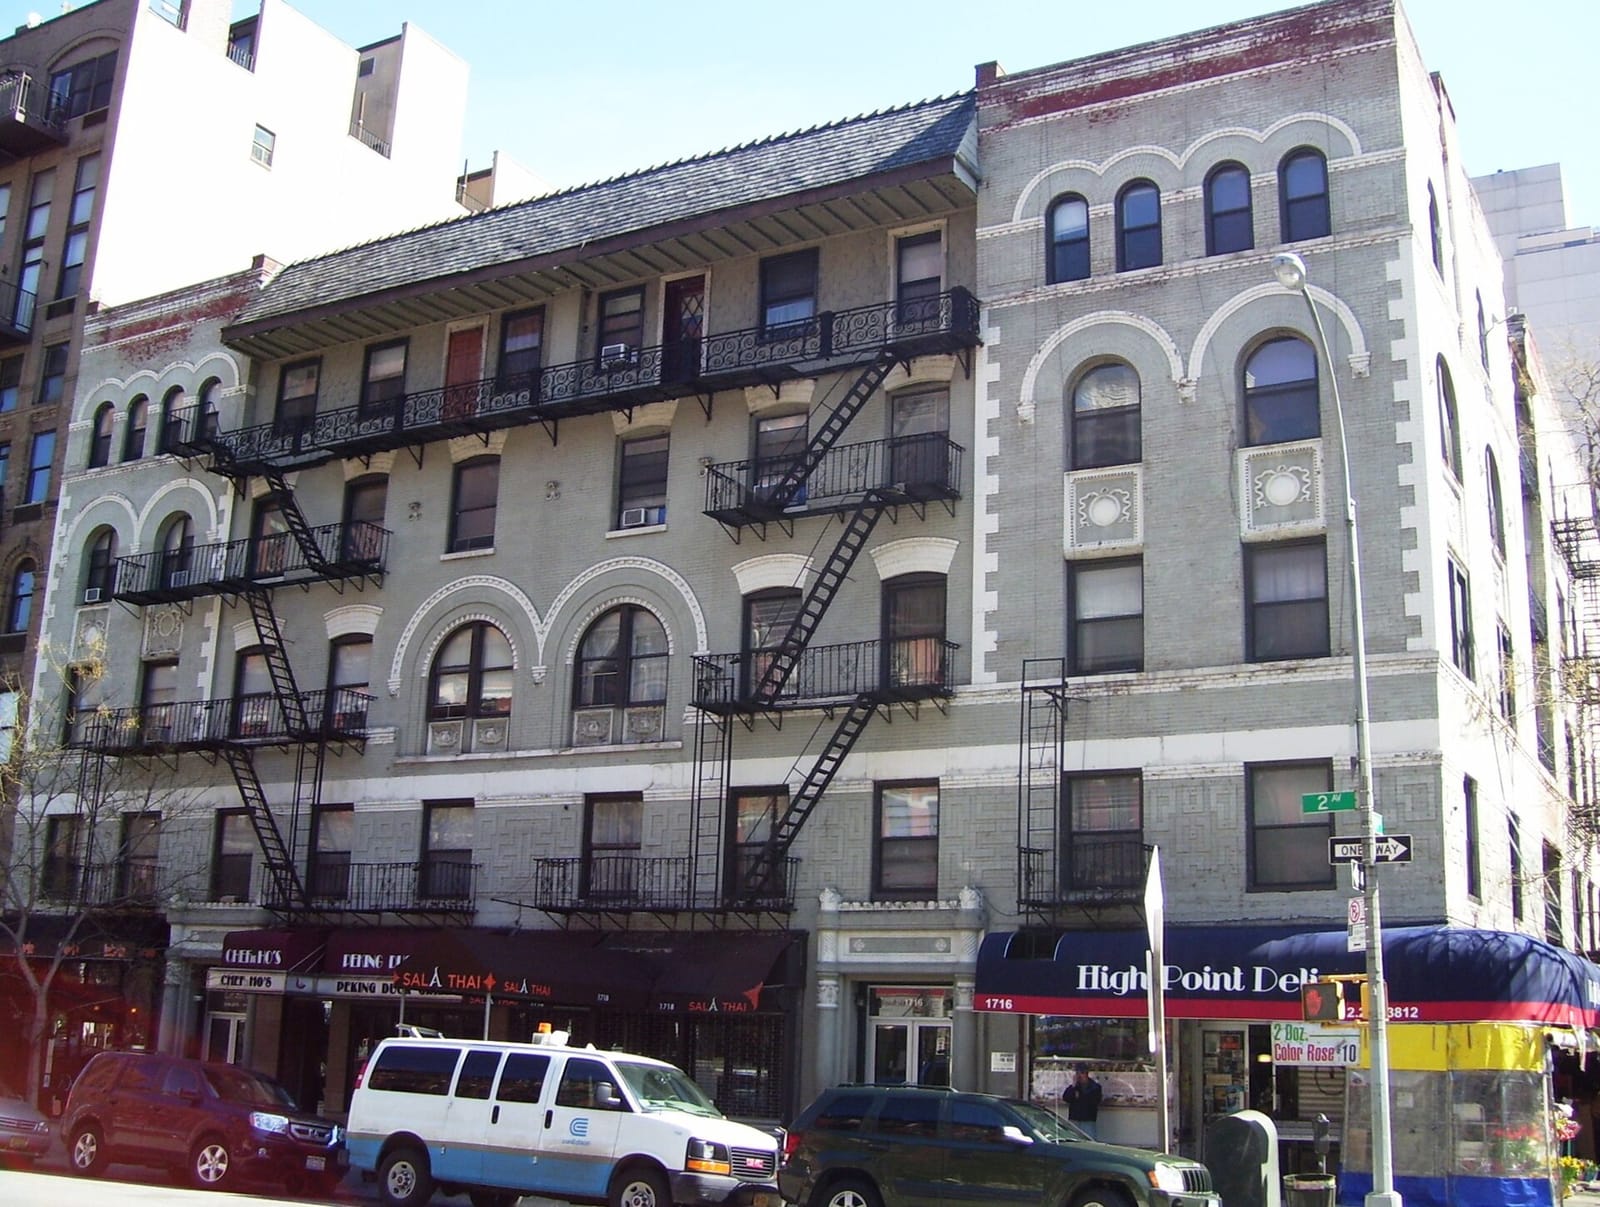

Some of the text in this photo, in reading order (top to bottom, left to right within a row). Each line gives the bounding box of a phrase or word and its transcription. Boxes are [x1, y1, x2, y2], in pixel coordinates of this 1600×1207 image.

[1318, 795, 1329, 811] 2
[1341, 843, 1399, 856] ONE WAY
[225, 949, 252, 963] CHEF
[342, 953, 383, 969] PEKING
[220, 974, 272, 988] CHEF HO'S
[336, 981, 376, 994] PEKING
[448, 974, 481, 989] THAI
[1076, 965, 1320, 996] High Point Deli
[531, 984, 552, 996] THAI
[722, 1001, 747, 1012] THAI
[904, 999, 923, 1007] 1716
[985, 998, 1013, 1010] 1716
[1273, 1023, 1309, 1041] 2 Doz.
[1274, 1043, 1303, 1062] Color
[1307, 1043, 1335, 1062] Rose
